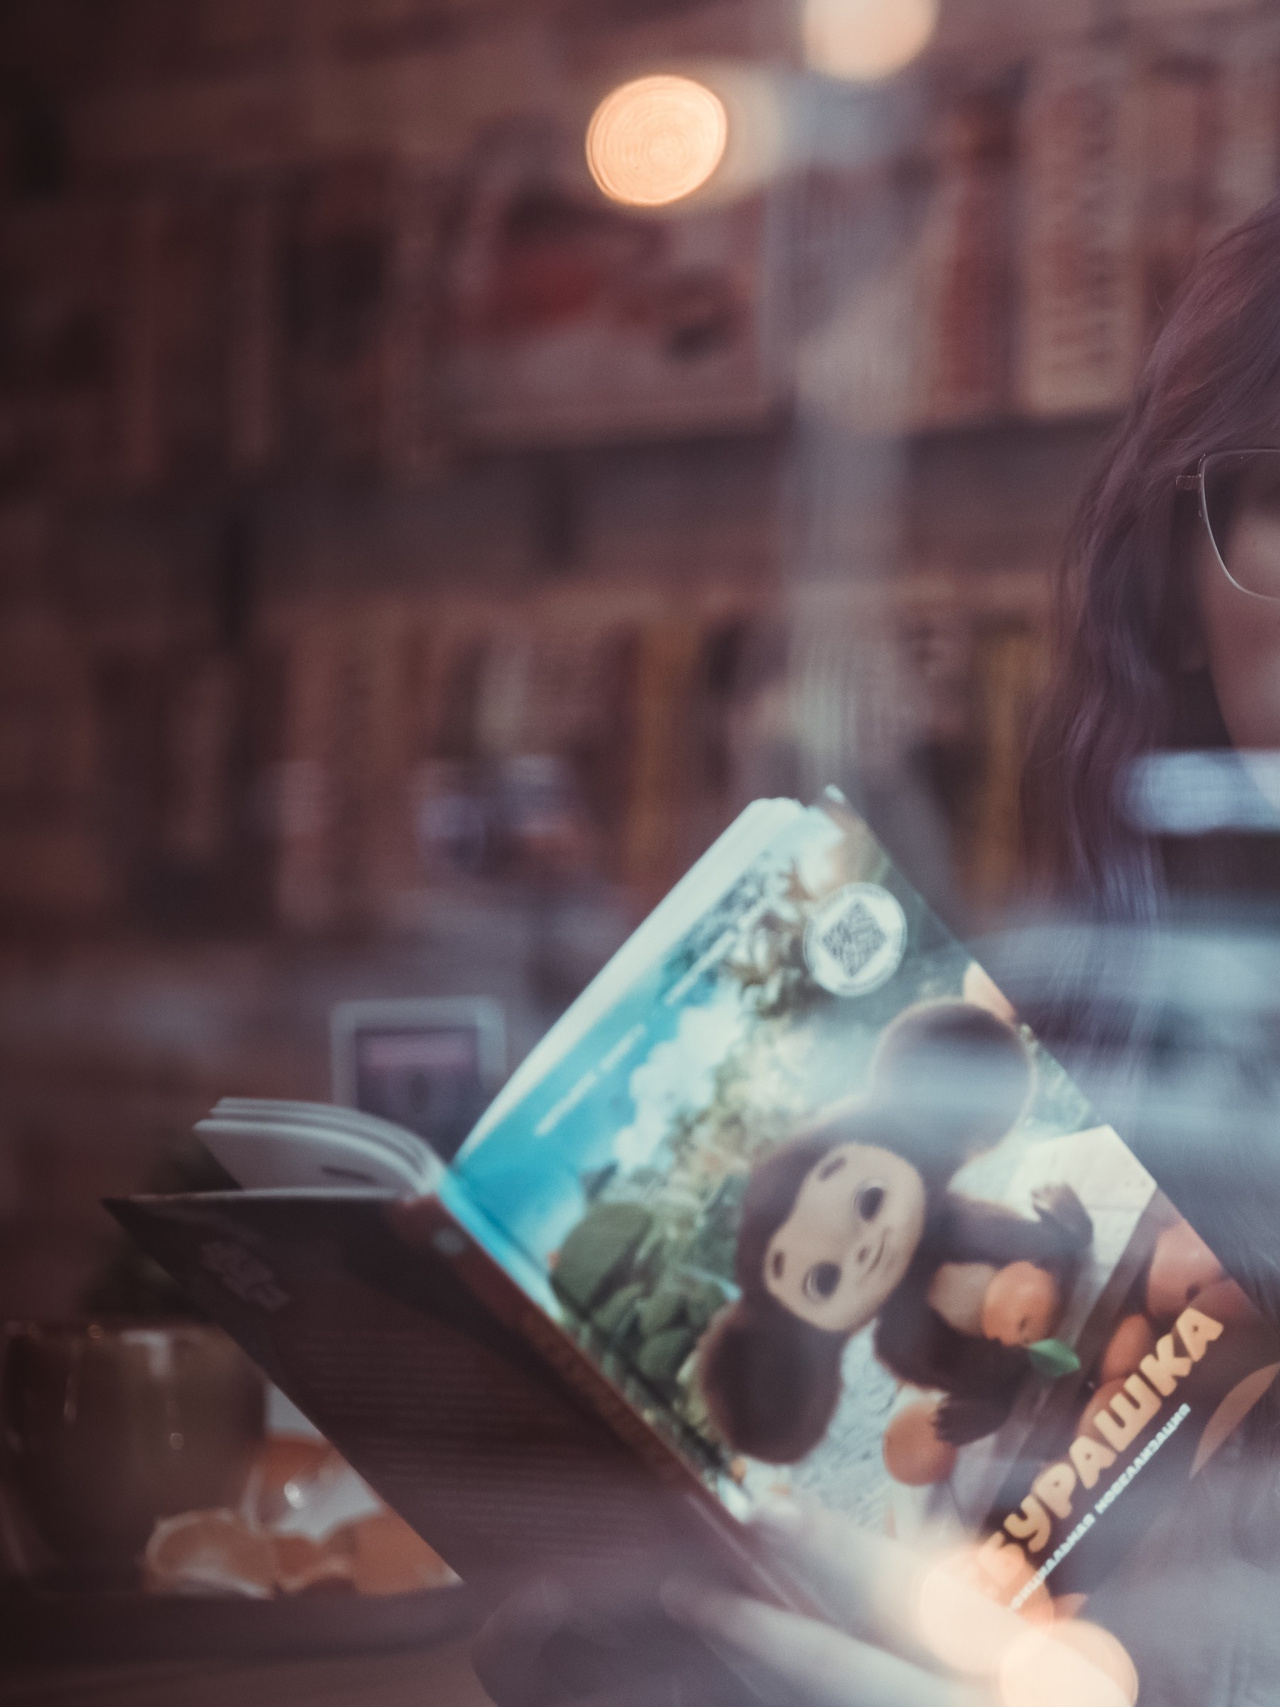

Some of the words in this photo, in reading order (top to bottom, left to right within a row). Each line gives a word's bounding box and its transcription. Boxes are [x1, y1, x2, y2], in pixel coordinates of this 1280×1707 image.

[961, 1307, 1224, 1598] БУРАШКА
[1010, 1513, 1096, 1610] ФИЦИАЛЬНАЯ
[1094, 1403, 1191, 1515] НОВЕЛЛИЗАЦИЯ
